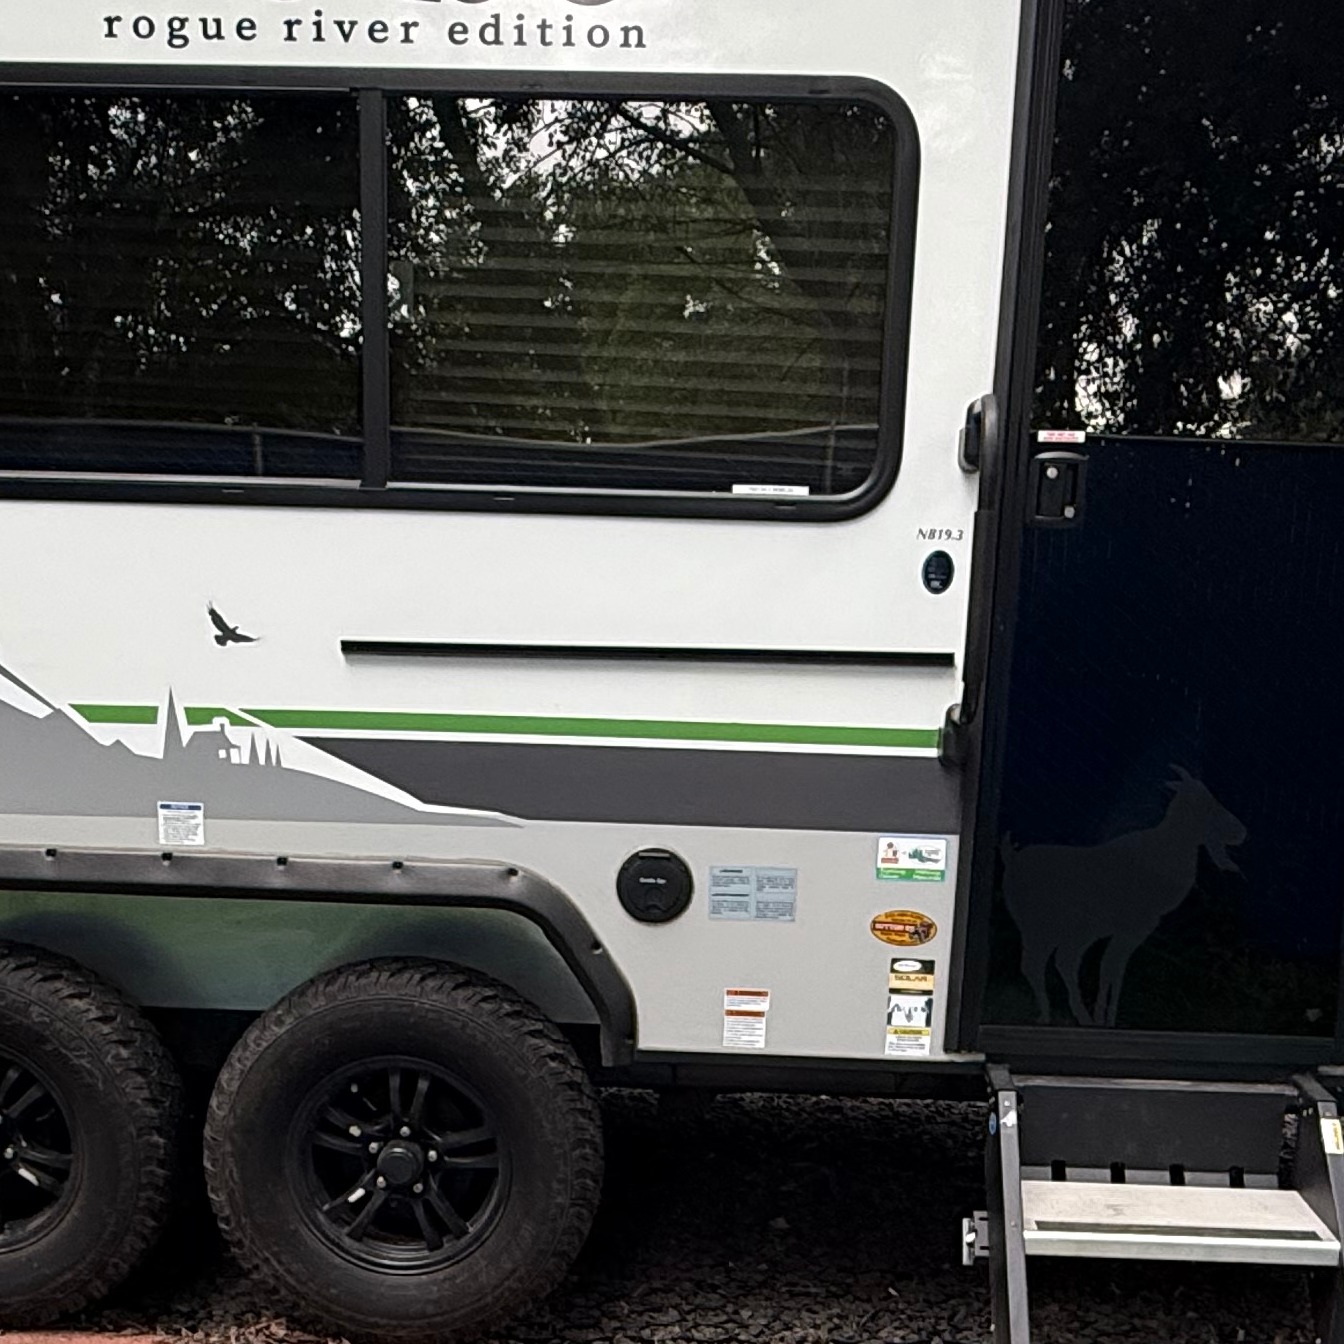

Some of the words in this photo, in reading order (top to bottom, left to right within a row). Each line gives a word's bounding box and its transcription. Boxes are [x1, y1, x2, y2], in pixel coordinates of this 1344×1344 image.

[103, 15, 257, 49] rogue
[283, 9, 420, 44] river
[447, 13, 647, 48] edition
[917, 527, 964, 541] NB19.3
